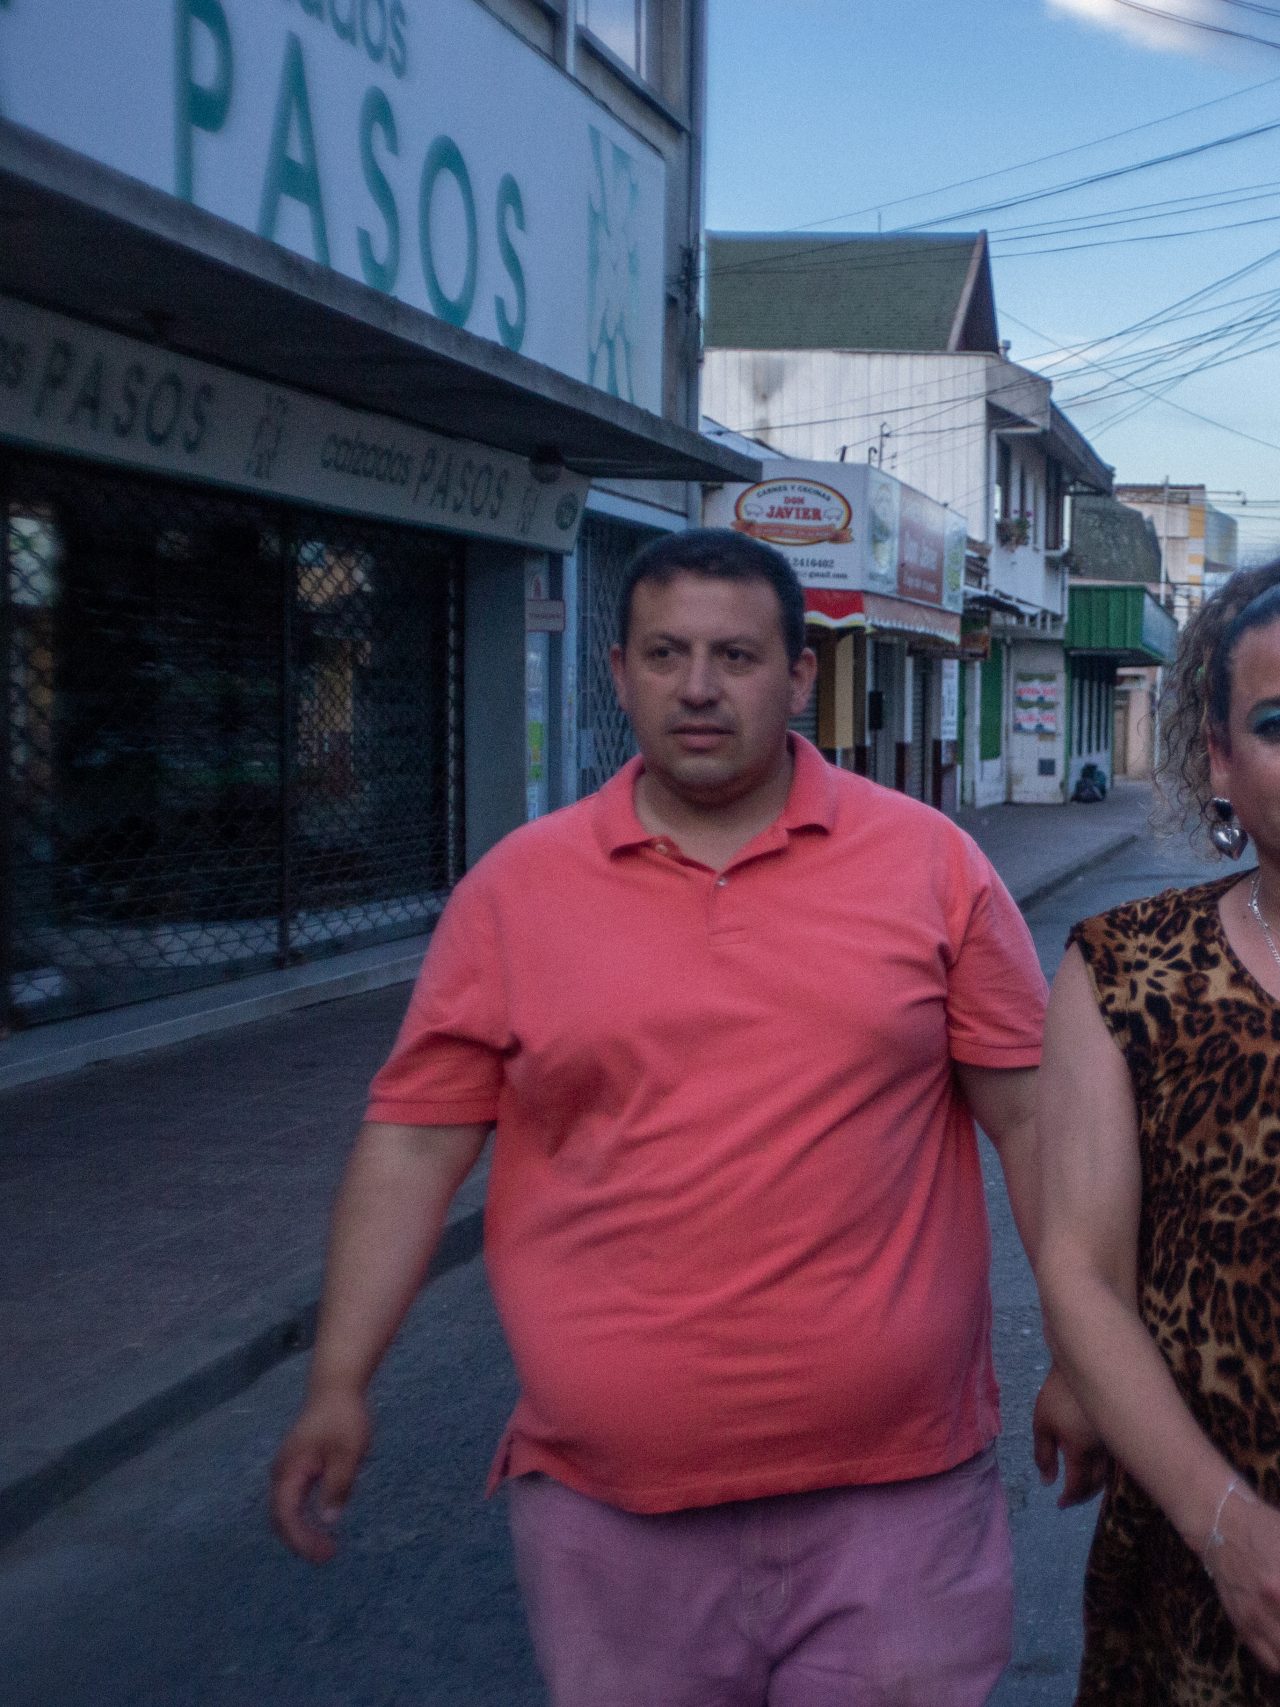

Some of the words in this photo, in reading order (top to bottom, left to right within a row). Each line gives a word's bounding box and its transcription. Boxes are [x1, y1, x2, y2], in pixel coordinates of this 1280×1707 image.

[177, 0, 527, 352] PASOS
[33, 337, 213, 453] PASOS
[413, 449, 508, 519] PASOS
[766, 505, 822, 521] JAVIER
